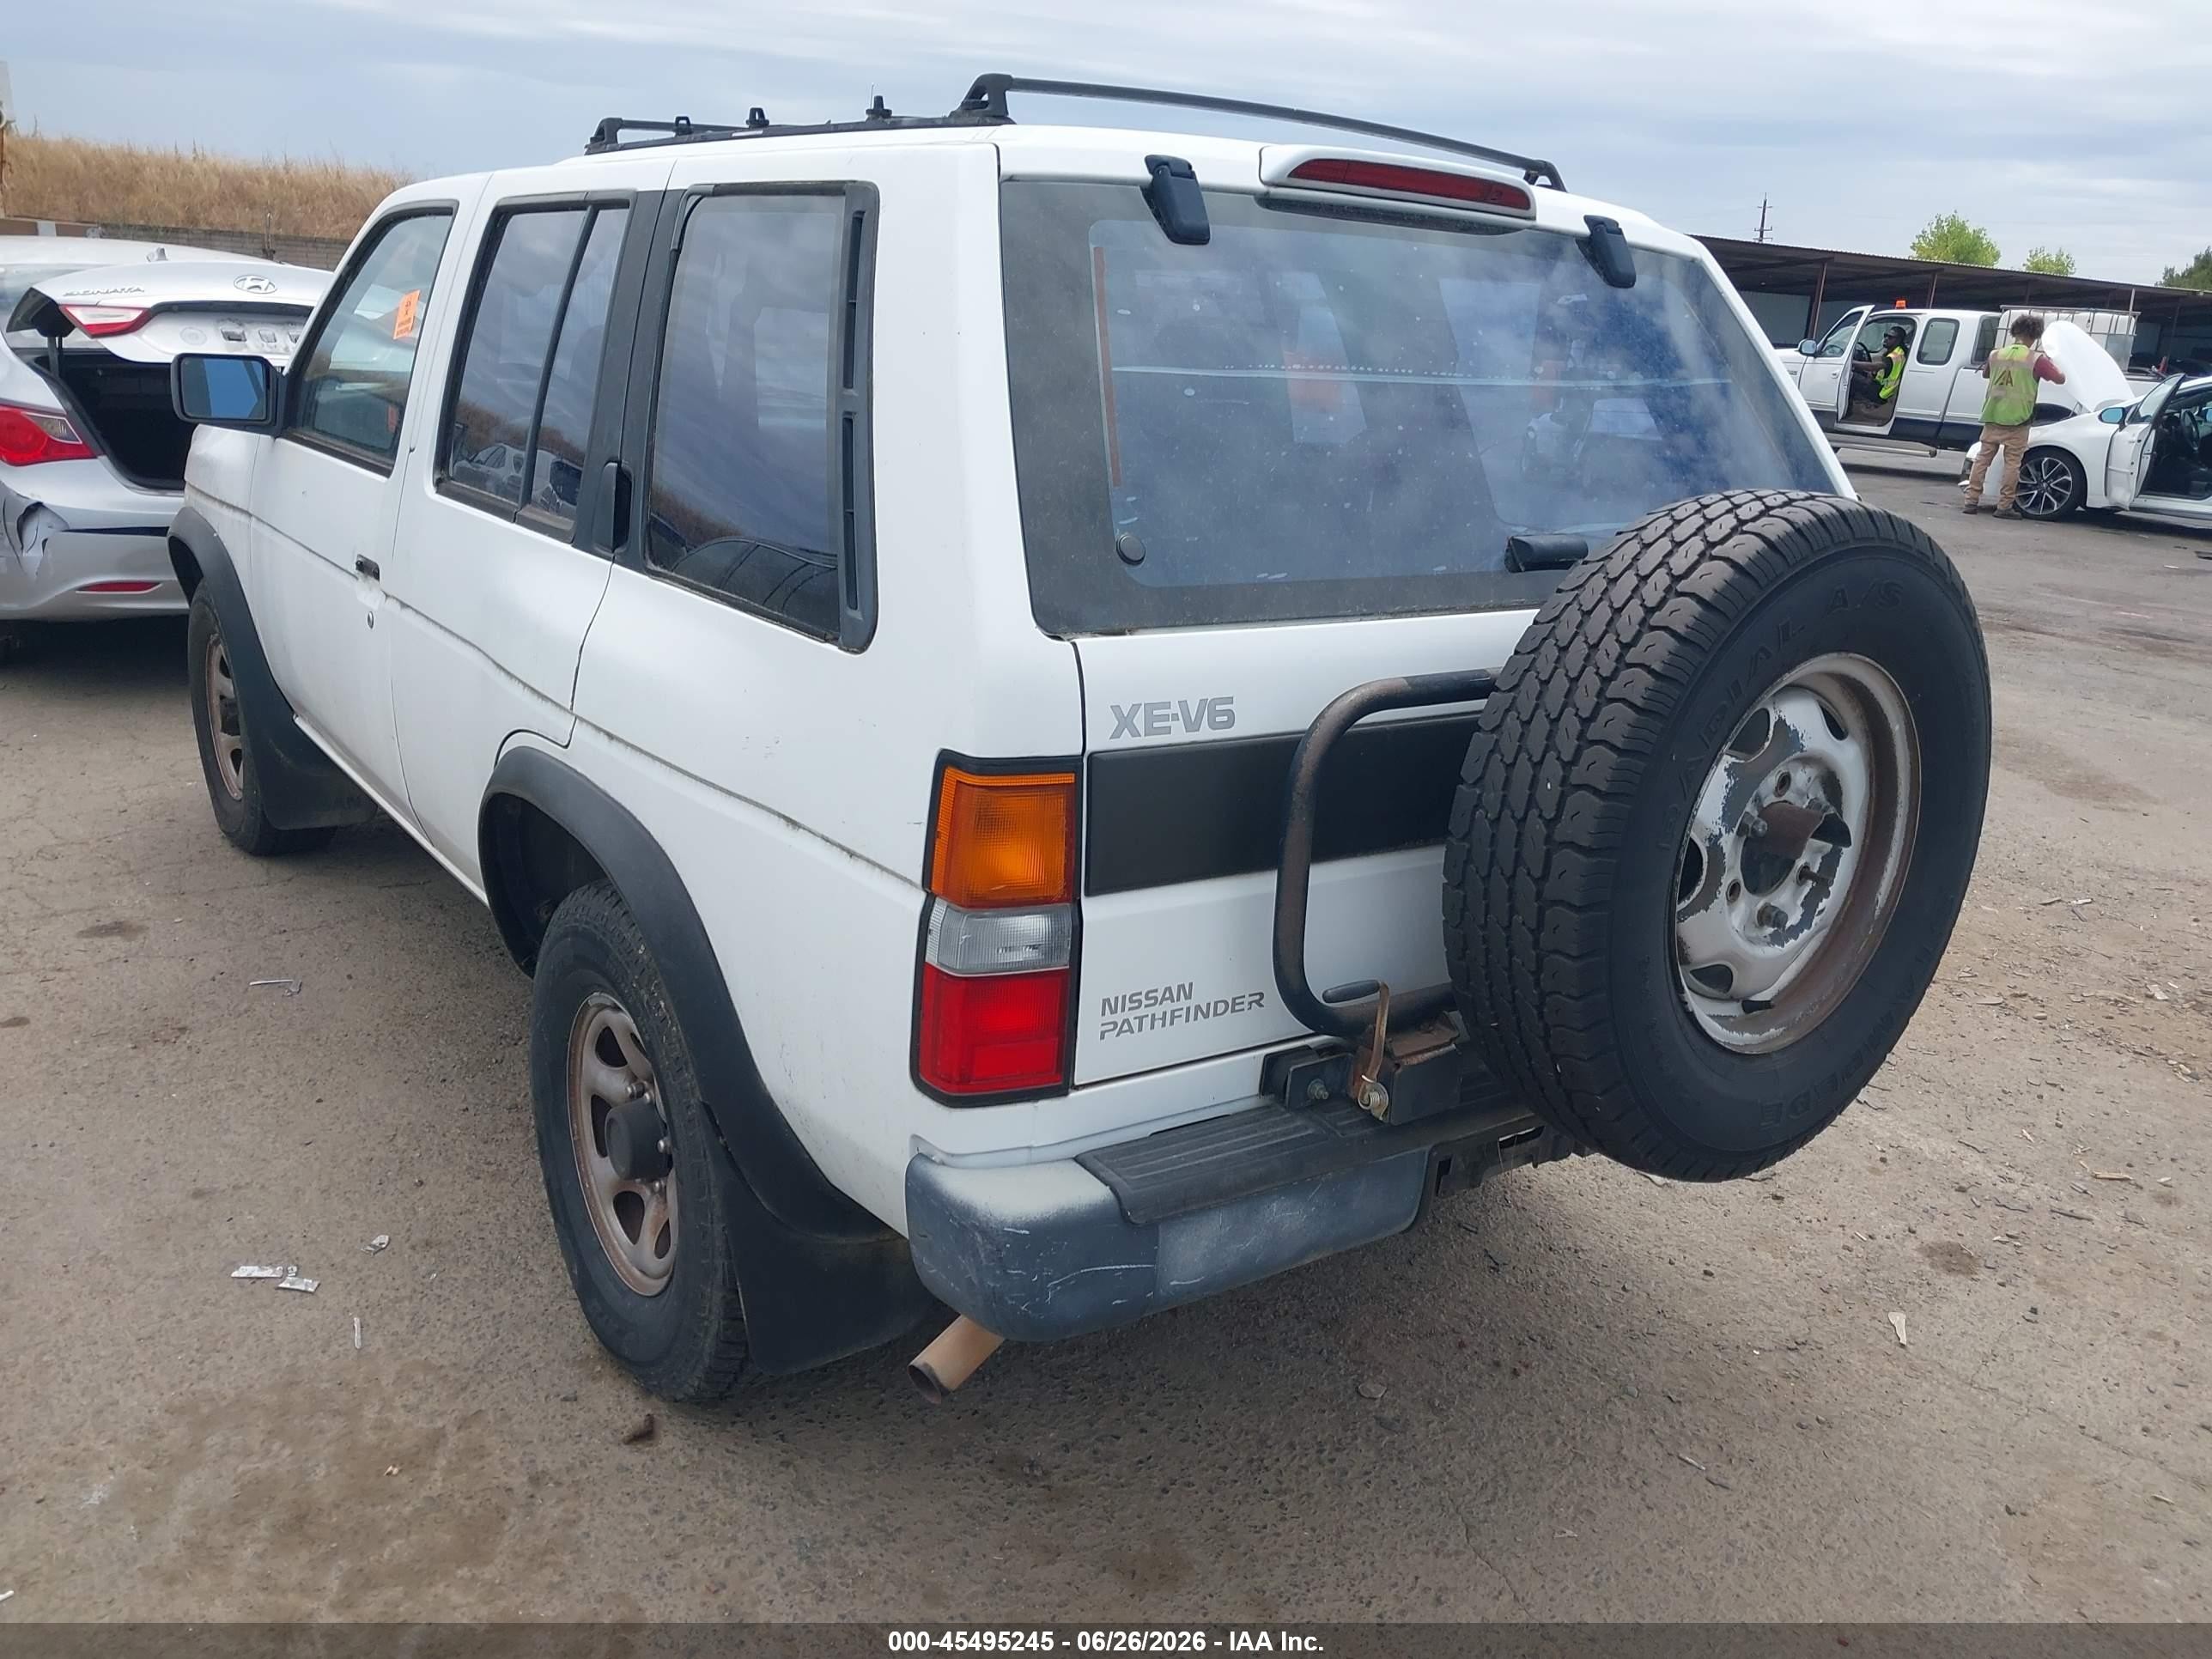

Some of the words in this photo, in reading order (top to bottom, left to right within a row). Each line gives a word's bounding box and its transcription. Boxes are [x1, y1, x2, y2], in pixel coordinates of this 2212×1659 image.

[1109, 696, 1235, 740] XE-V6
[1099, 991, 1265, 1042] PATHFINDER
[1101, 981, 1194, 1018] NISSAN
